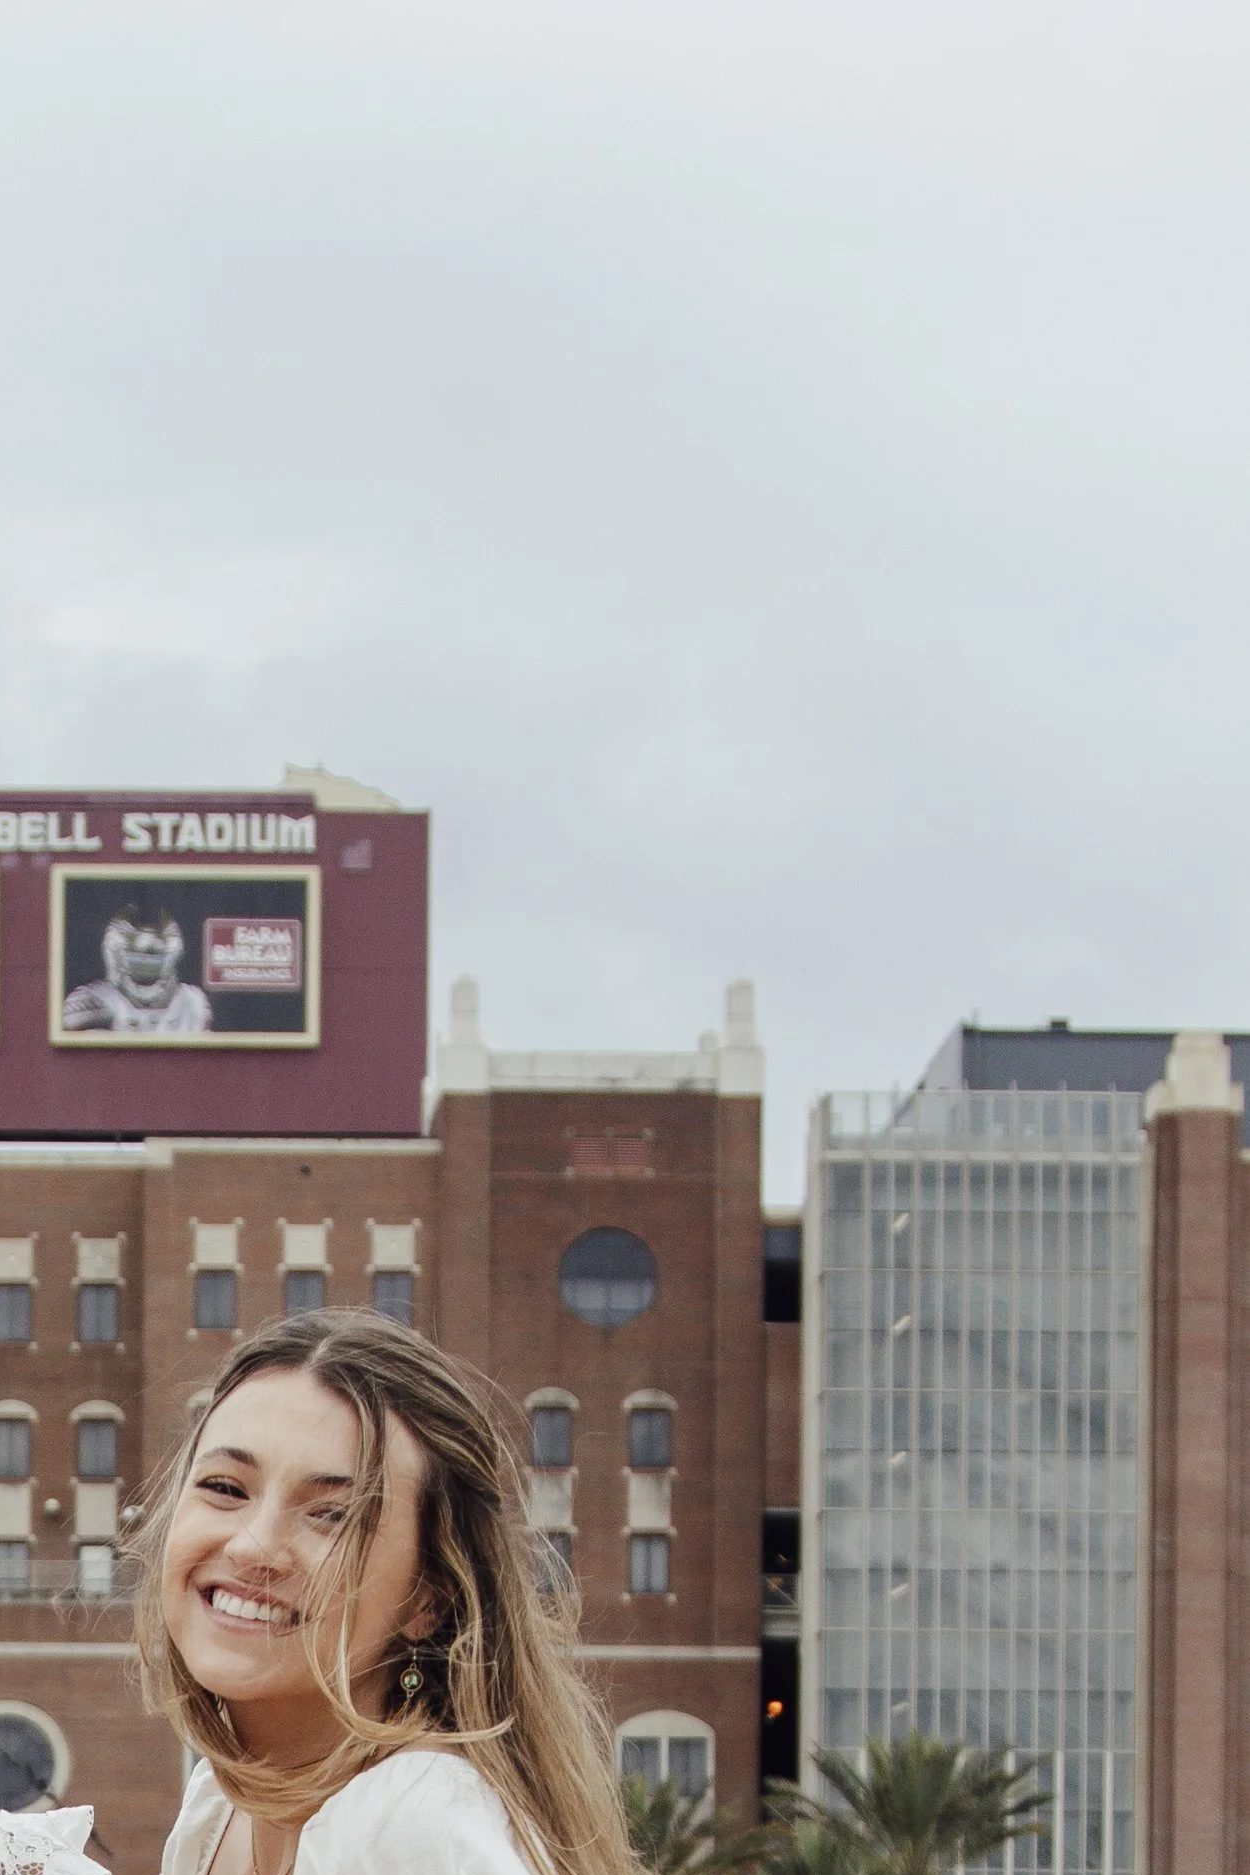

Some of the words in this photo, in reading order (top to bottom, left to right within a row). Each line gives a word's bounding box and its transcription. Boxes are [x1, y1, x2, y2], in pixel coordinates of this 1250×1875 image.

[121, 812, 316, 853] STADIUM
[235, 925, 291, 944] FARM
[212, 943, 291, 962] BUREAU
